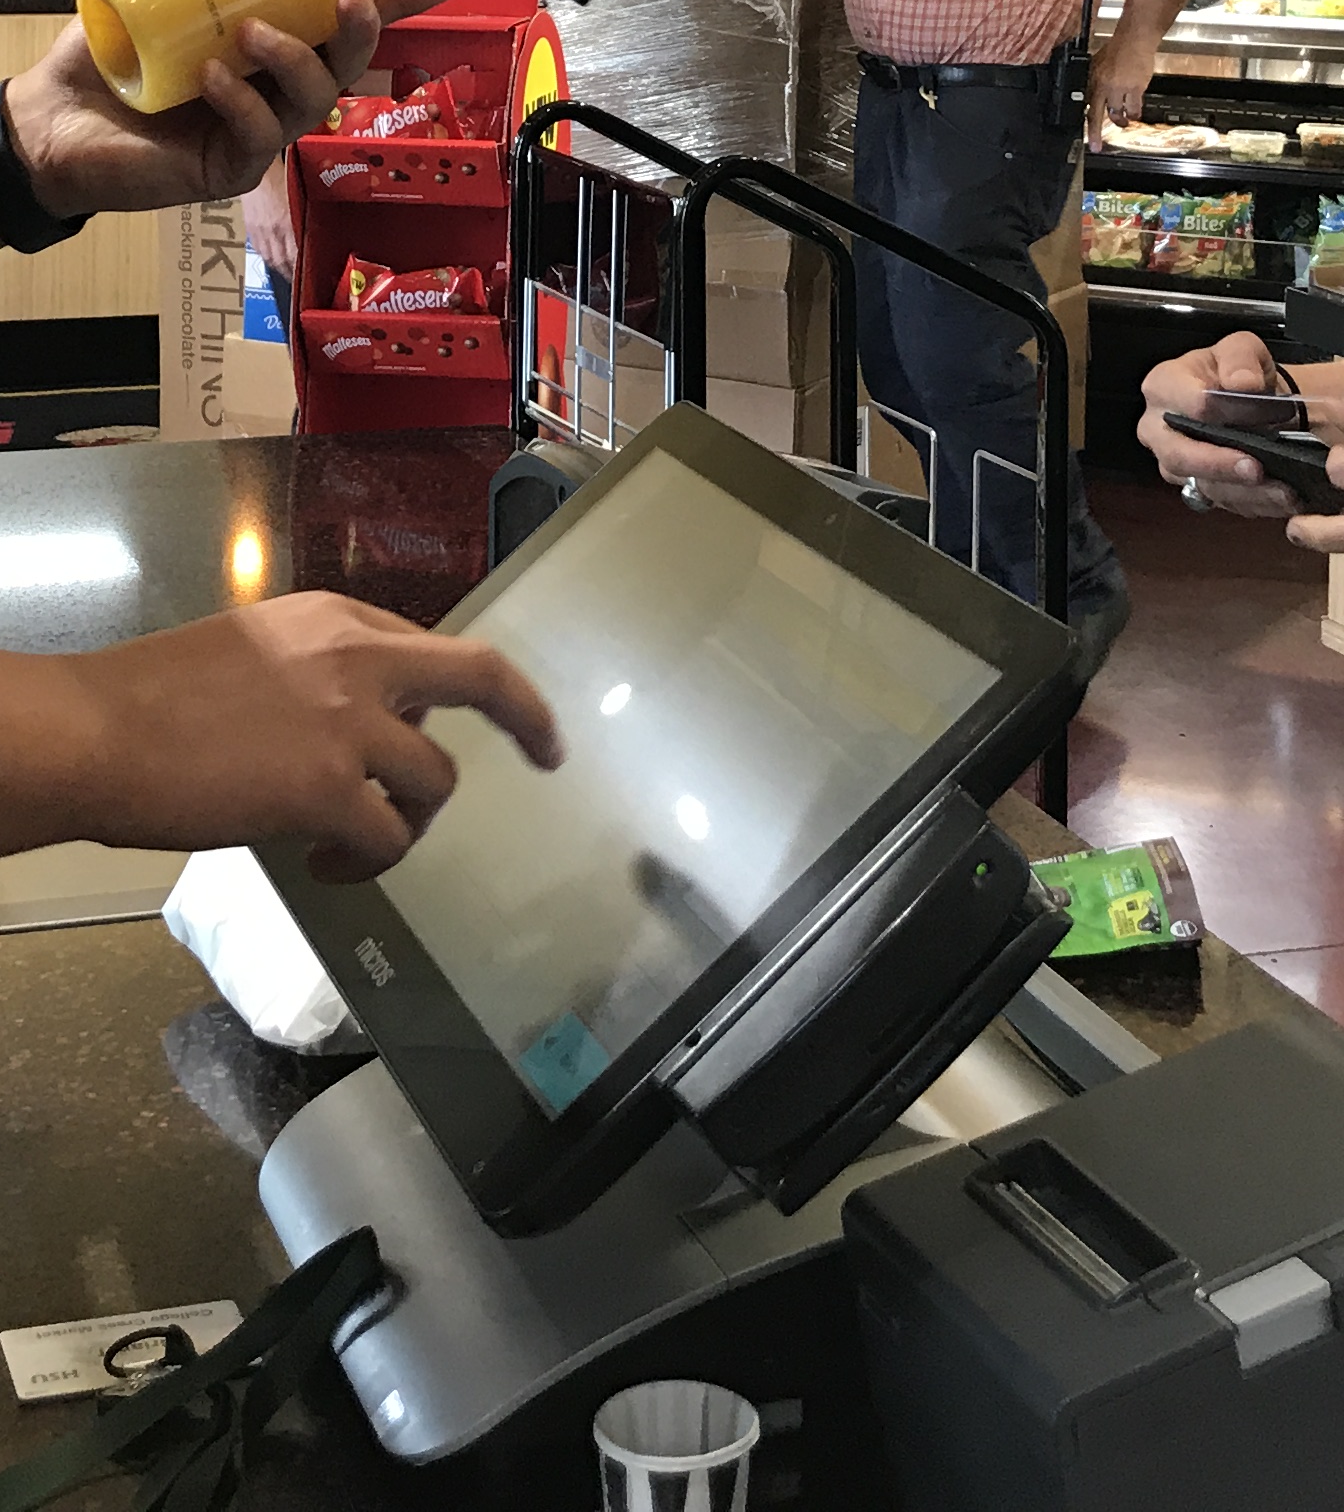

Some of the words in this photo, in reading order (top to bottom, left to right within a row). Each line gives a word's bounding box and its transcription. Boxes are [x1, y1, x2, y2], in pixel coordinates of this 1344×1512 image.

[318, 162, 369, 187] Maltesers
[1098, 199, 1141, 215] Bites
[1183, 214, 1227, 232] Bites
[178, 202, 194, 275] nacking
[179, 276, 197, 370] chocolate
[322, 337, 372, 361] Maltesers
[353, 936, 397, 988] micros
[97, 1317, 147, 1331] Creek
[150, 1308, 213, 1322] College
[35, 1325, 93, 1340] Market
[31, 1368, 80, 1385] HSU
